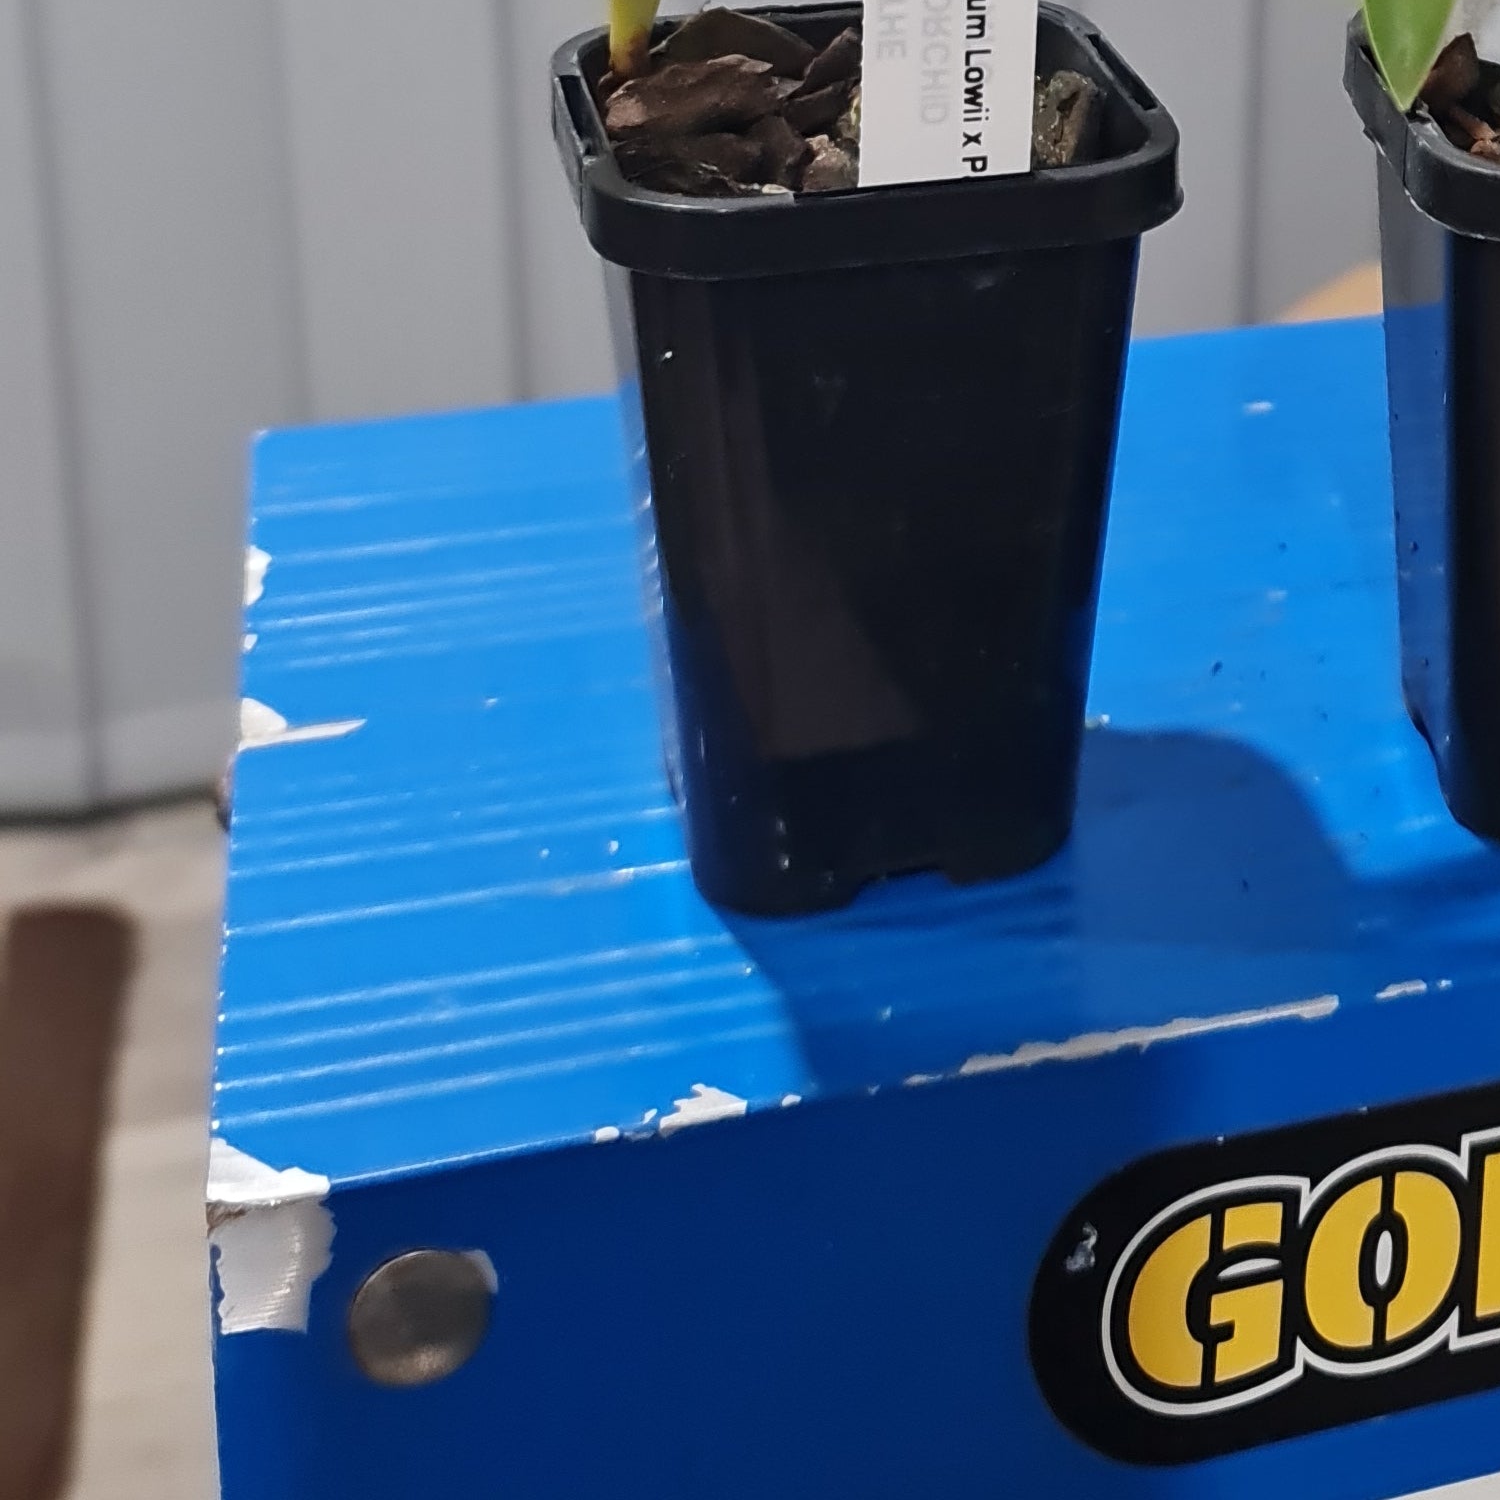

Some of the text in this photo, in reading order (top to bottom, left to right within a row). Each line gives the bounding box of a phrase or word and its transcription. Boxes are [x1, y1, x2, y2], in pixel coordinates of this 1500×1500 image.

[963, 48, 992, 123] Lowii
[961, 130, 982, 148] x
[961, 154, 988, 174] P
